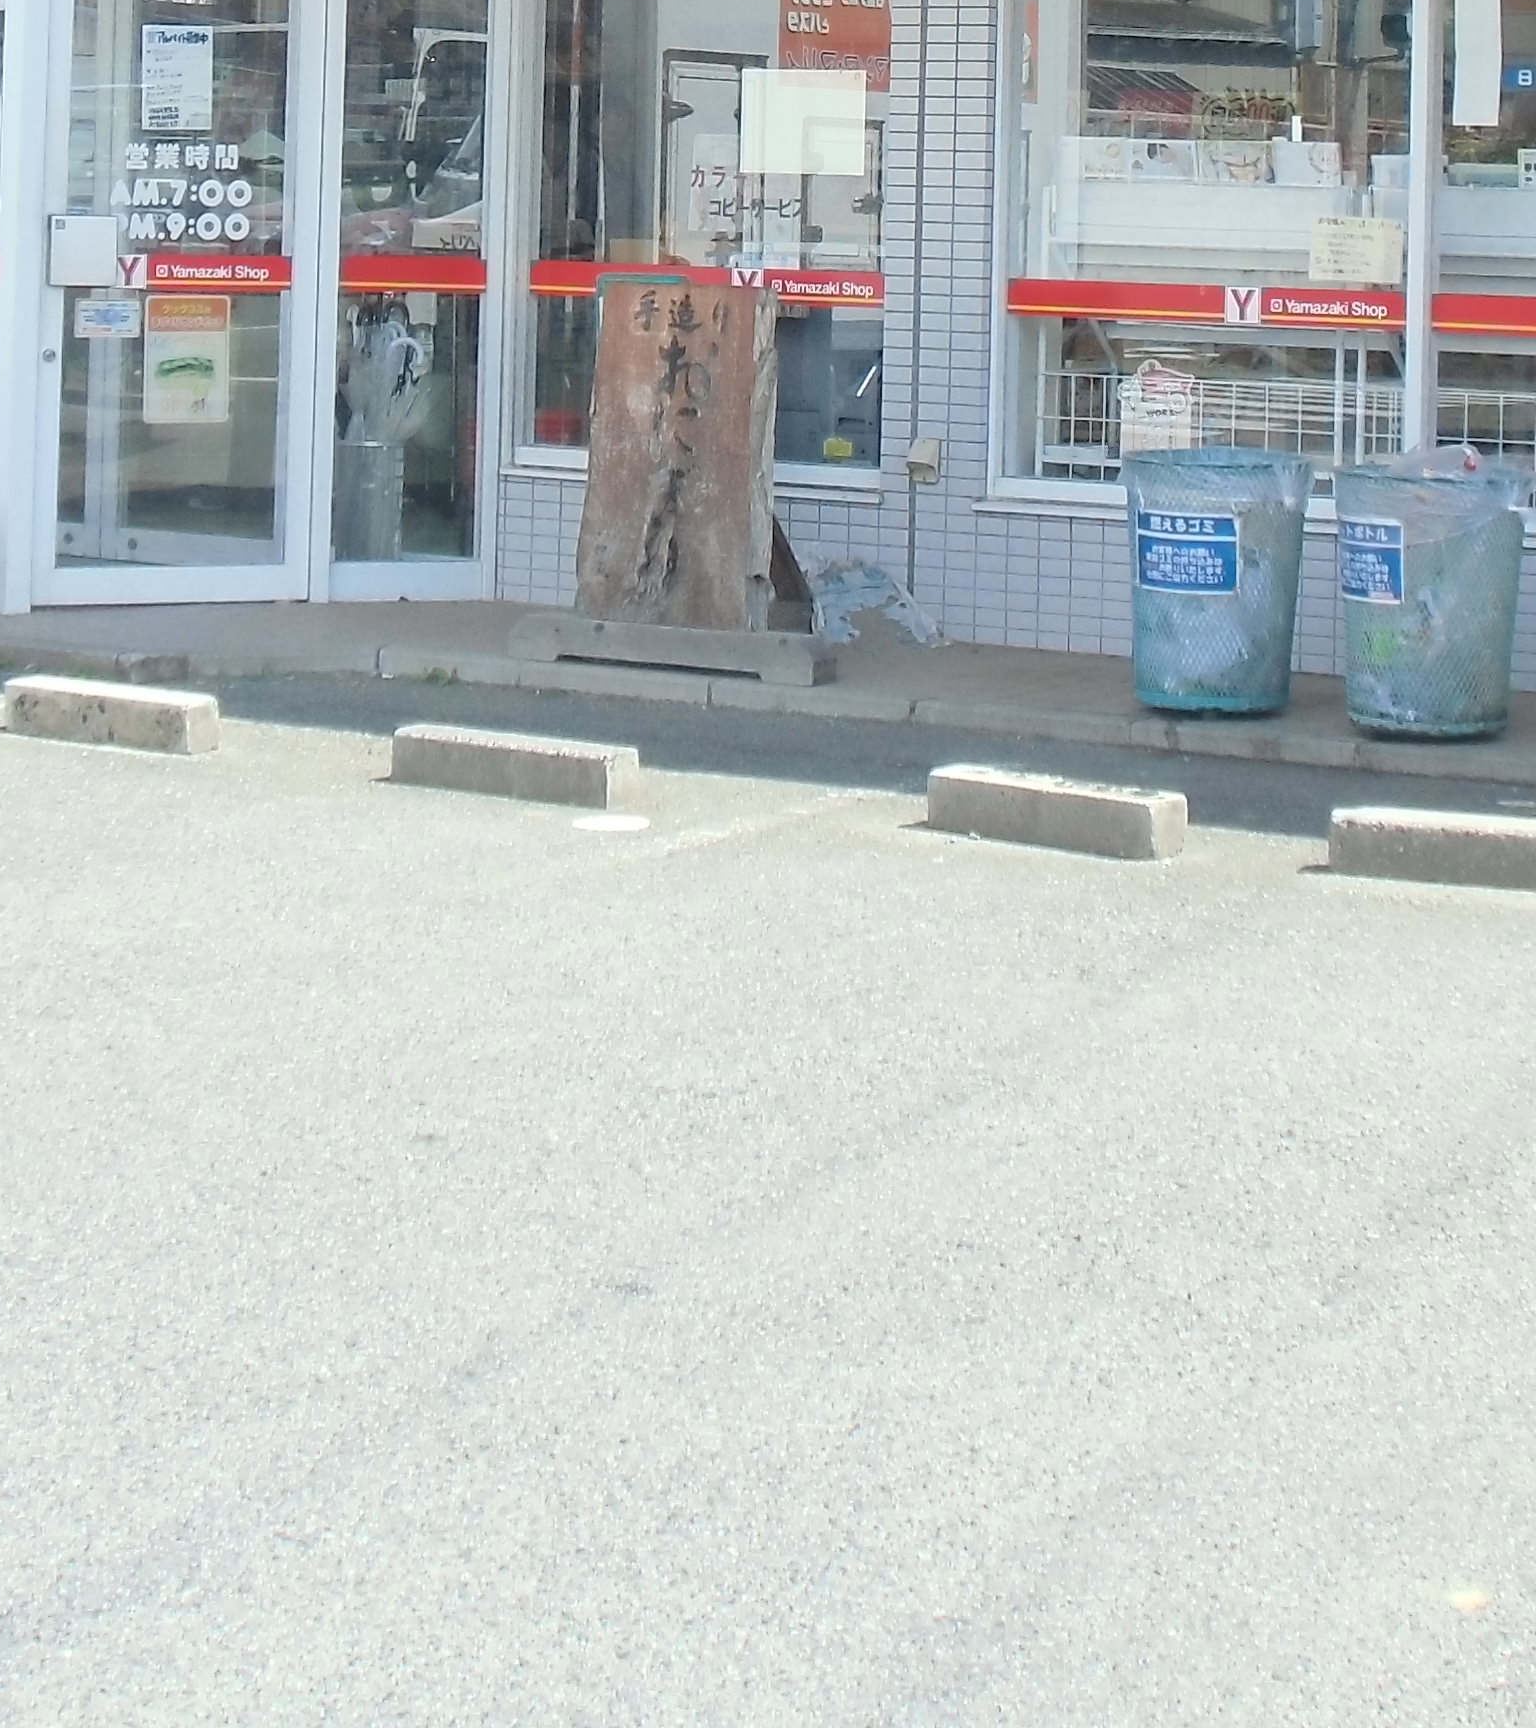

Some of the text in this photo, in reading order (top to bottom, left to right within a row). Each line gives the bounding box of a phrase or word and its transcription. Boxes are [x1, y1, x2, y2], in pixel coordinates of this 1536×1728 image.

[125, 142, 239, 171] 営業時間
[170, 265, 270, 282] Yamazaki Shop
[783, 279, 874, 298] Yamazaki Shop
[1284, 298, 1388, 320] Yamazaki Shop
[1150, 515, 1215, 534] 燃えるゴミ
